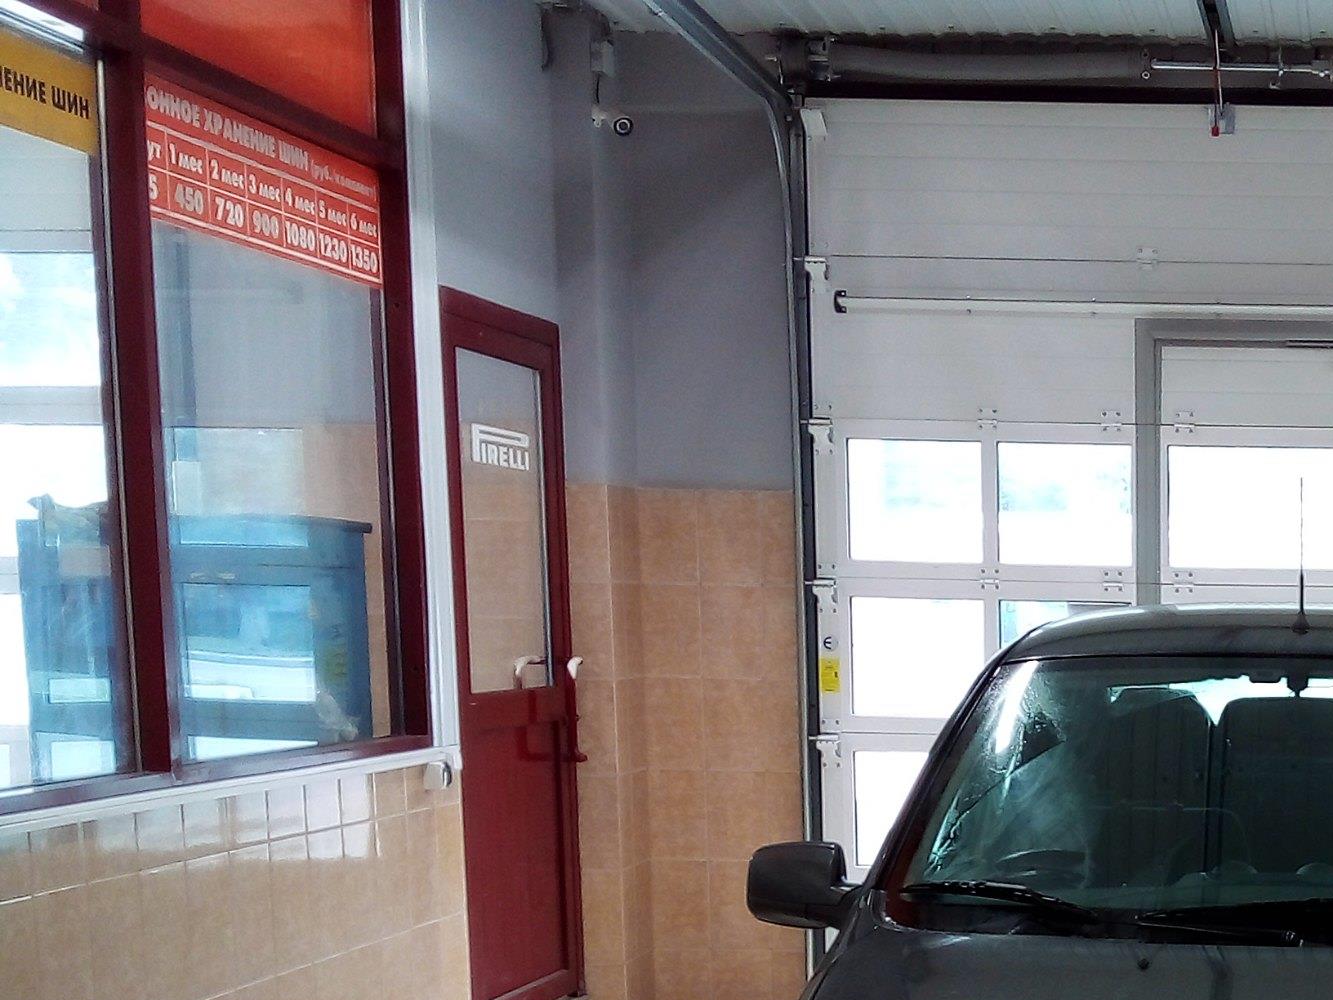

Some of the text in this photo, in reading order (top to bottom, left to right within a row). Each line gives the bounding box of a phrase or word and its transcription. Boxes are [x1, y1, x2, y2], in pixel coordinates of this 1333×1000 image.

[51, 85, 90, 120] ШИН
[203, 107, 276, 159] ХРАНЕНИЕ
[279, 139, 309, 172] ШИН
[169, 143, 177, 165] 1
[178, 152, 203, 175] мес
[210, 158, 220, 180] 2
[221, 168, 245, 190] мес
[248, 173, 257, 194] 3
[258, 182, 281, 203] мес
[285, 187, 293, 207] 4
[294, 195, 316, 216] мес
[319, 199, 327, 219] 5
[327, 208, 348, 227] мес
[350, 212, 358, 230] 6
[358, 219, 377, 237] мес
[175, 182, 204, 216] 450
[214, 195, 244, 228] 720
[252, 209, 279, 239] 900
[285, 220, 316, 252] 1080
[320, 232, 349, 263] 1230
[350, 243, 378, 274] 1350
[471, 422, 530, 471] PIRELLI
